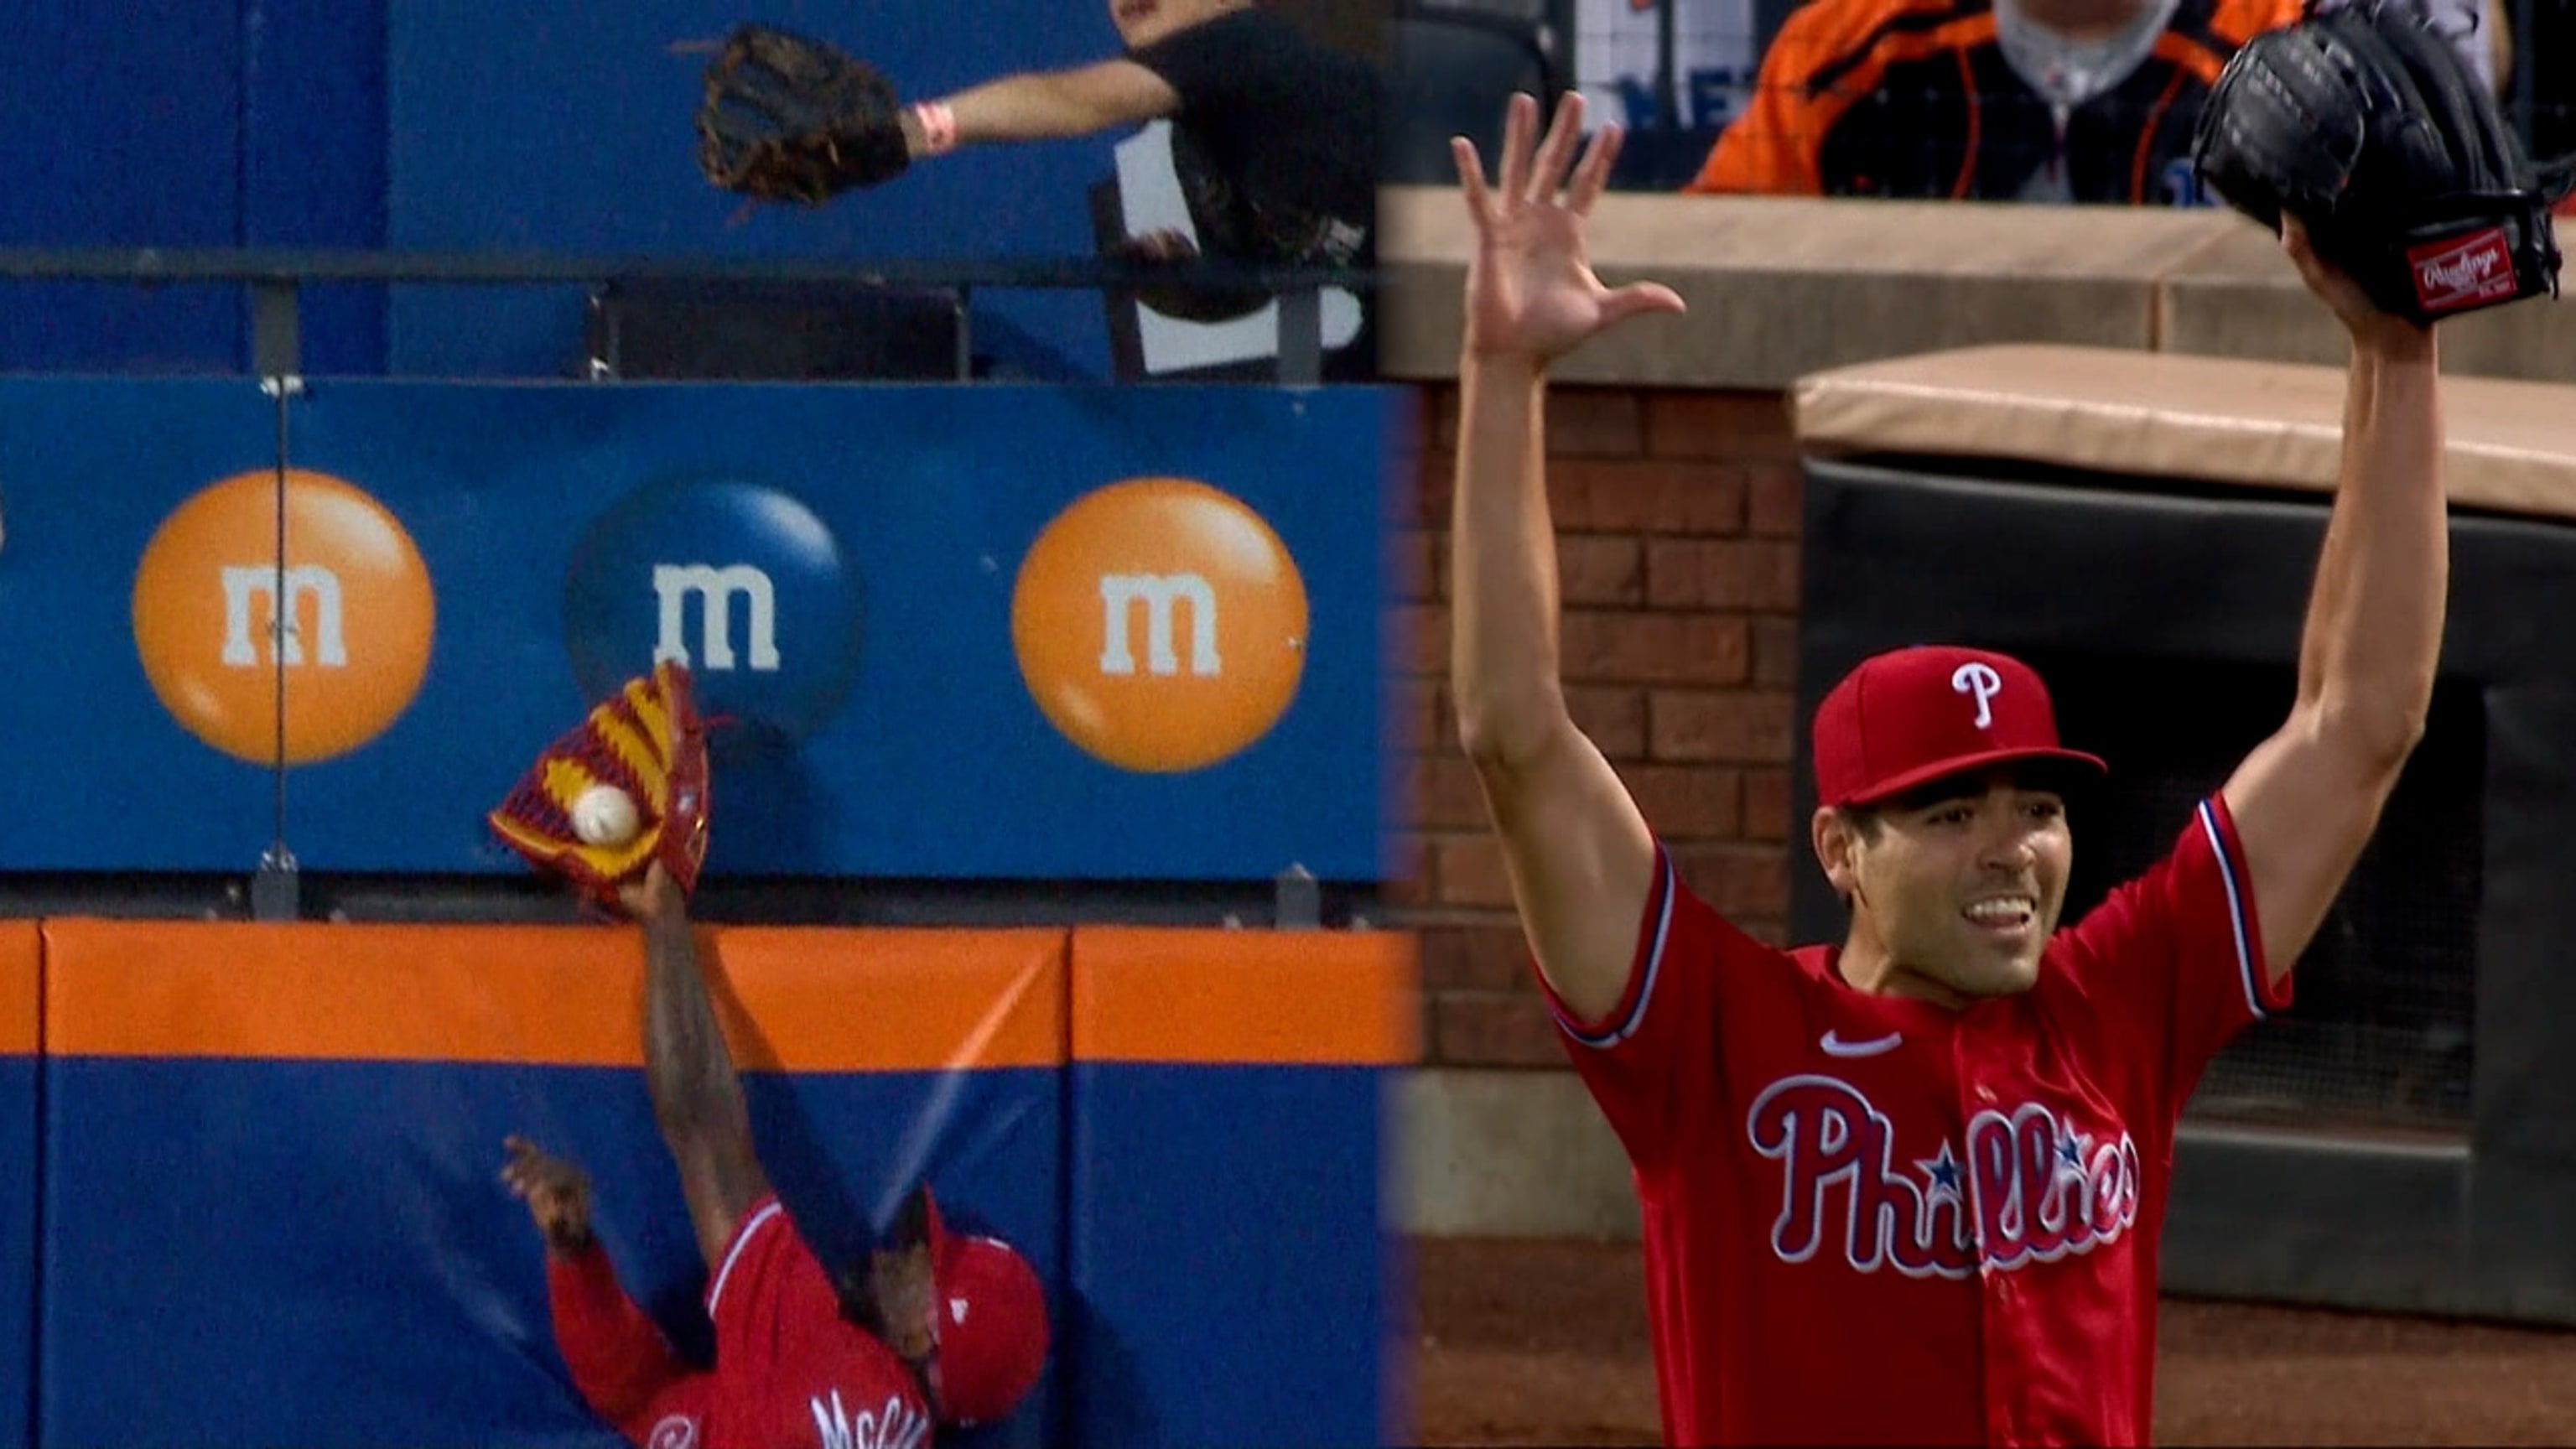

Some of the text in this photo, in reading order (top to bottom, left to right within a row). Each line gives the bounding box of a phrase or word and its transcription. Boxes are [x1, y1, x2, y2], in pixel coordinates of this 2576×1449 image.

[221, 564, 348, 667] m
[652, 564, 781, 670] m
[1099, 572, 1221, 676] m
[1950, 662, 2002, 729] P
[1747, 1073, 2138, 1278] Phillies
